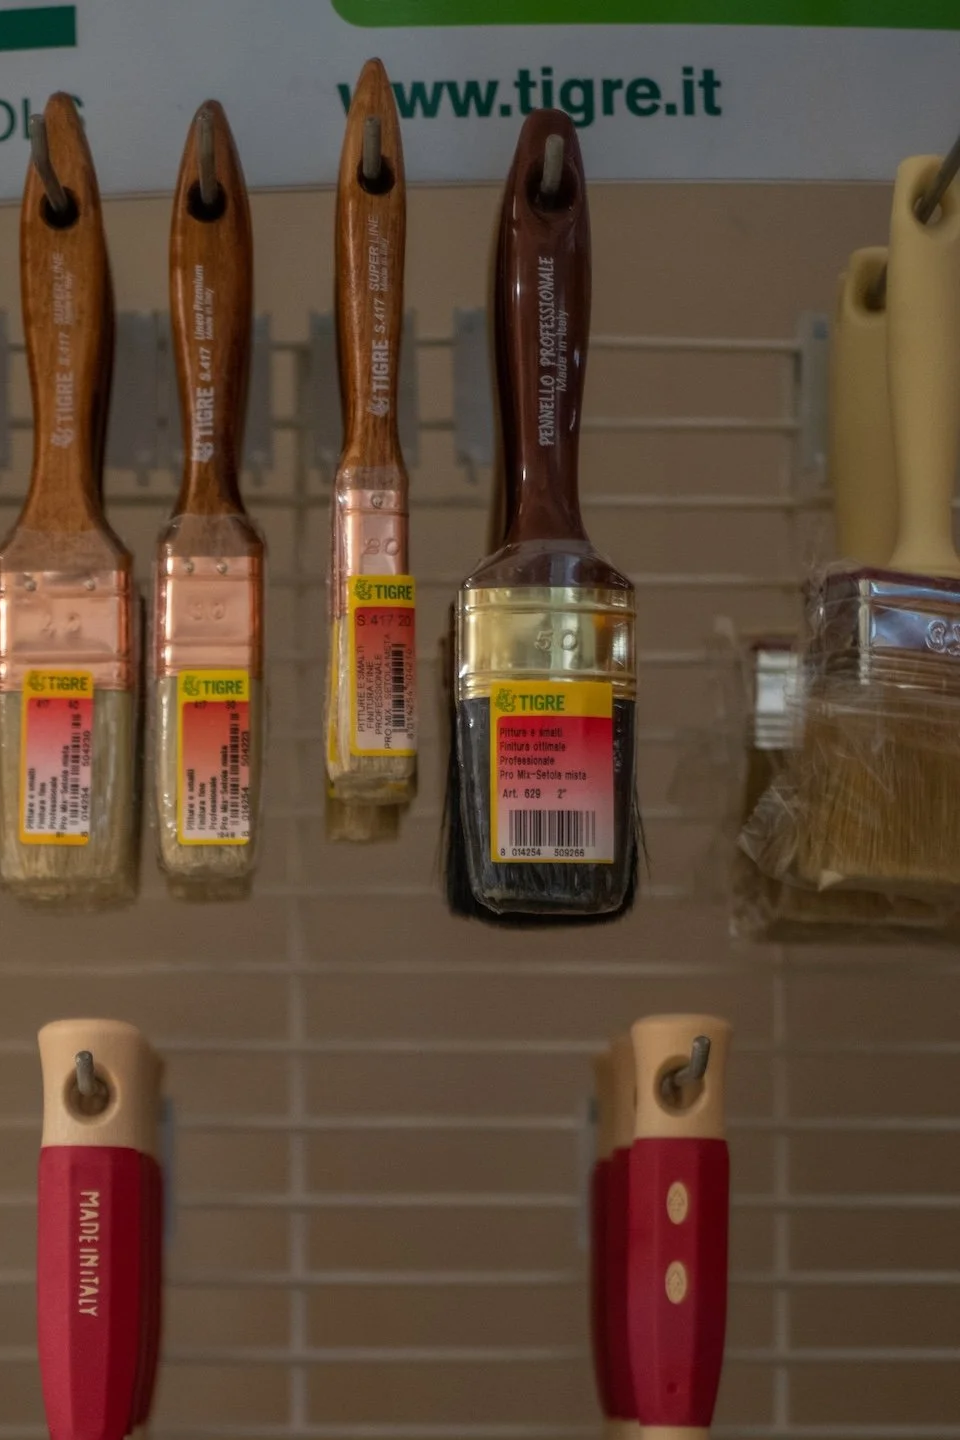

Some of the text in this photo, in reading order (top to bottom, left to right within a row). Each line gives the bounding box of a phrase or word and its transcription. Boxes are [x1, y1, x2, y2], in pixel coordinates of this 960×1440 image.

[557, 309, 570, 338] Italy
[371, 298, 390, 397] TIGRE S.417
[537, 256, 556, 446] PENNELLO PROFESSIONALE
[556, 354, 568, 392] Made
[54, 371, 75, 425] TIGRE
[196, 386, 215, 444] TIGRE
[375, 584, 413, 600] TIGRE
[47, 675, 90, 692] TIGRE
[201, 679, 245, 696] TIGRE
[519, 694, 566, 711] TIGRE
[500, 727, 528, 739] Pitture
[500, 741, 567, 752] Finitura ottimale
[500, 755, 556, 766] Professionale
[500, 770, 514, 780] Pro
[565, 770, 588, 780] mista
[502, 789, 519, 799] Art.
[524, 788, 542, 799] 629
[512, 847, 542, 857] 014254
[78, 1191, 101, 1318] MADE IN ITALY
